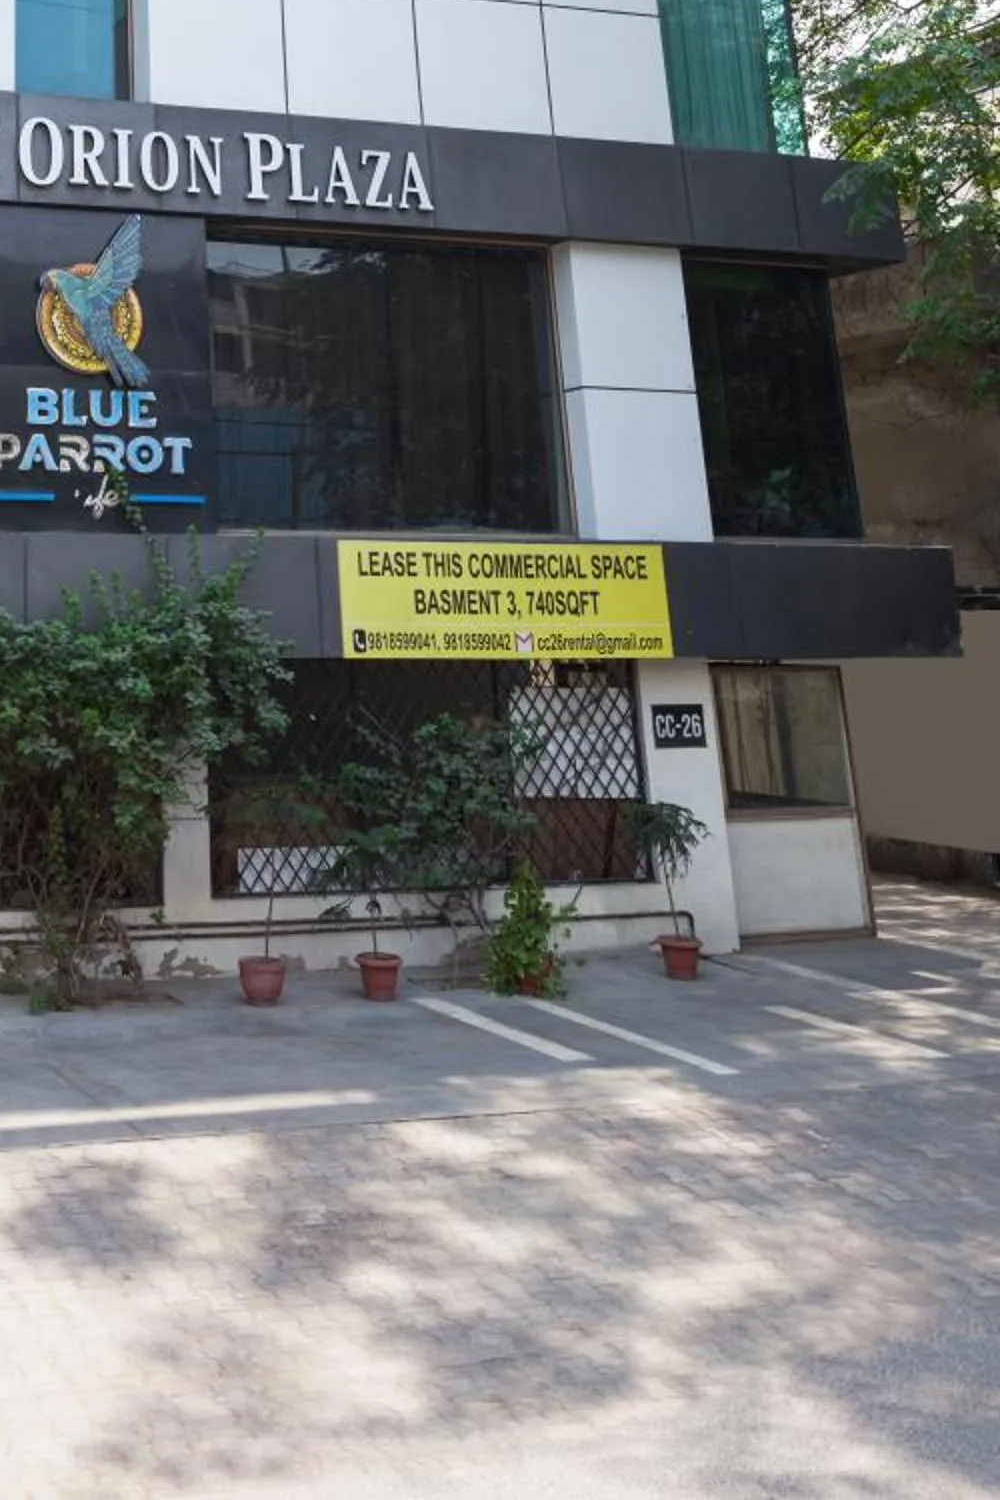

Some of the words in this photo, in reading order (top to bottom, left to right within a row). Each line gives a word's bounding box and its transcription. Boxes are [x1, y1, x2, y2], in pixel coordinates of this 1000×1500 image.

[17, 116, 224, 197] ORION
[242, 130, 434, 212] PLAZA
[25, 387, 158, 428] BLUE
[356, 551, 418, 577] LEASE
[425, 552, 463, 579] THIS
[467, 553, 588, 580] COMMERCIAL
[591, 555, 649, 580] SPACE
[414, 588, 502, 615] BASMENT
[506, 590, 522, 620] 3,
[526, 590, 601, 617] 740SQFT
[537, 632, 663, 655] cc26rental@gmail.com
[655, 714, 702, 739] CC-26
